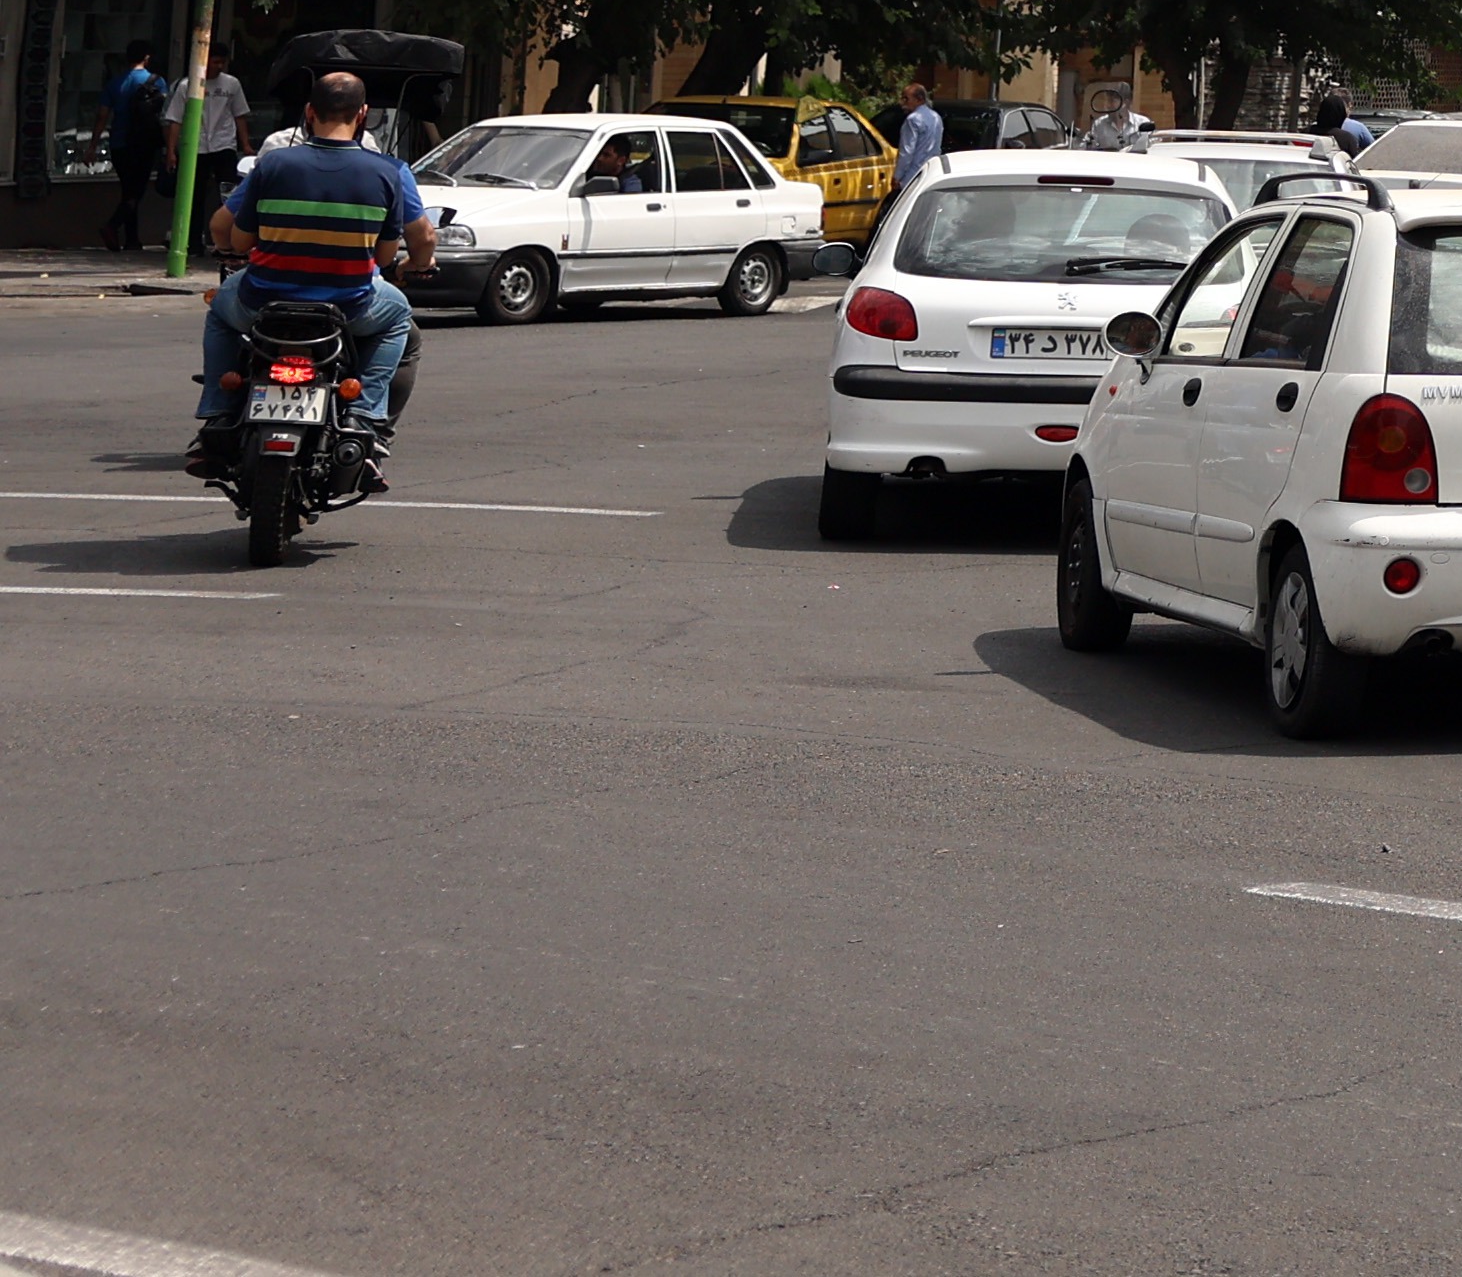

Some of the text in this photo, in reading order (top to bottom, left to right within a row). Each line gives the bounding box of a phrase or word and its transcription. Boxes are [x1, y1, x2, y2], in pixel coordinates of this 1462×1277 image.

[1008, 332, 1105, 356] ۳۴ د ۳۷۸
[903, 350, 960, 359] PEUGEOT
